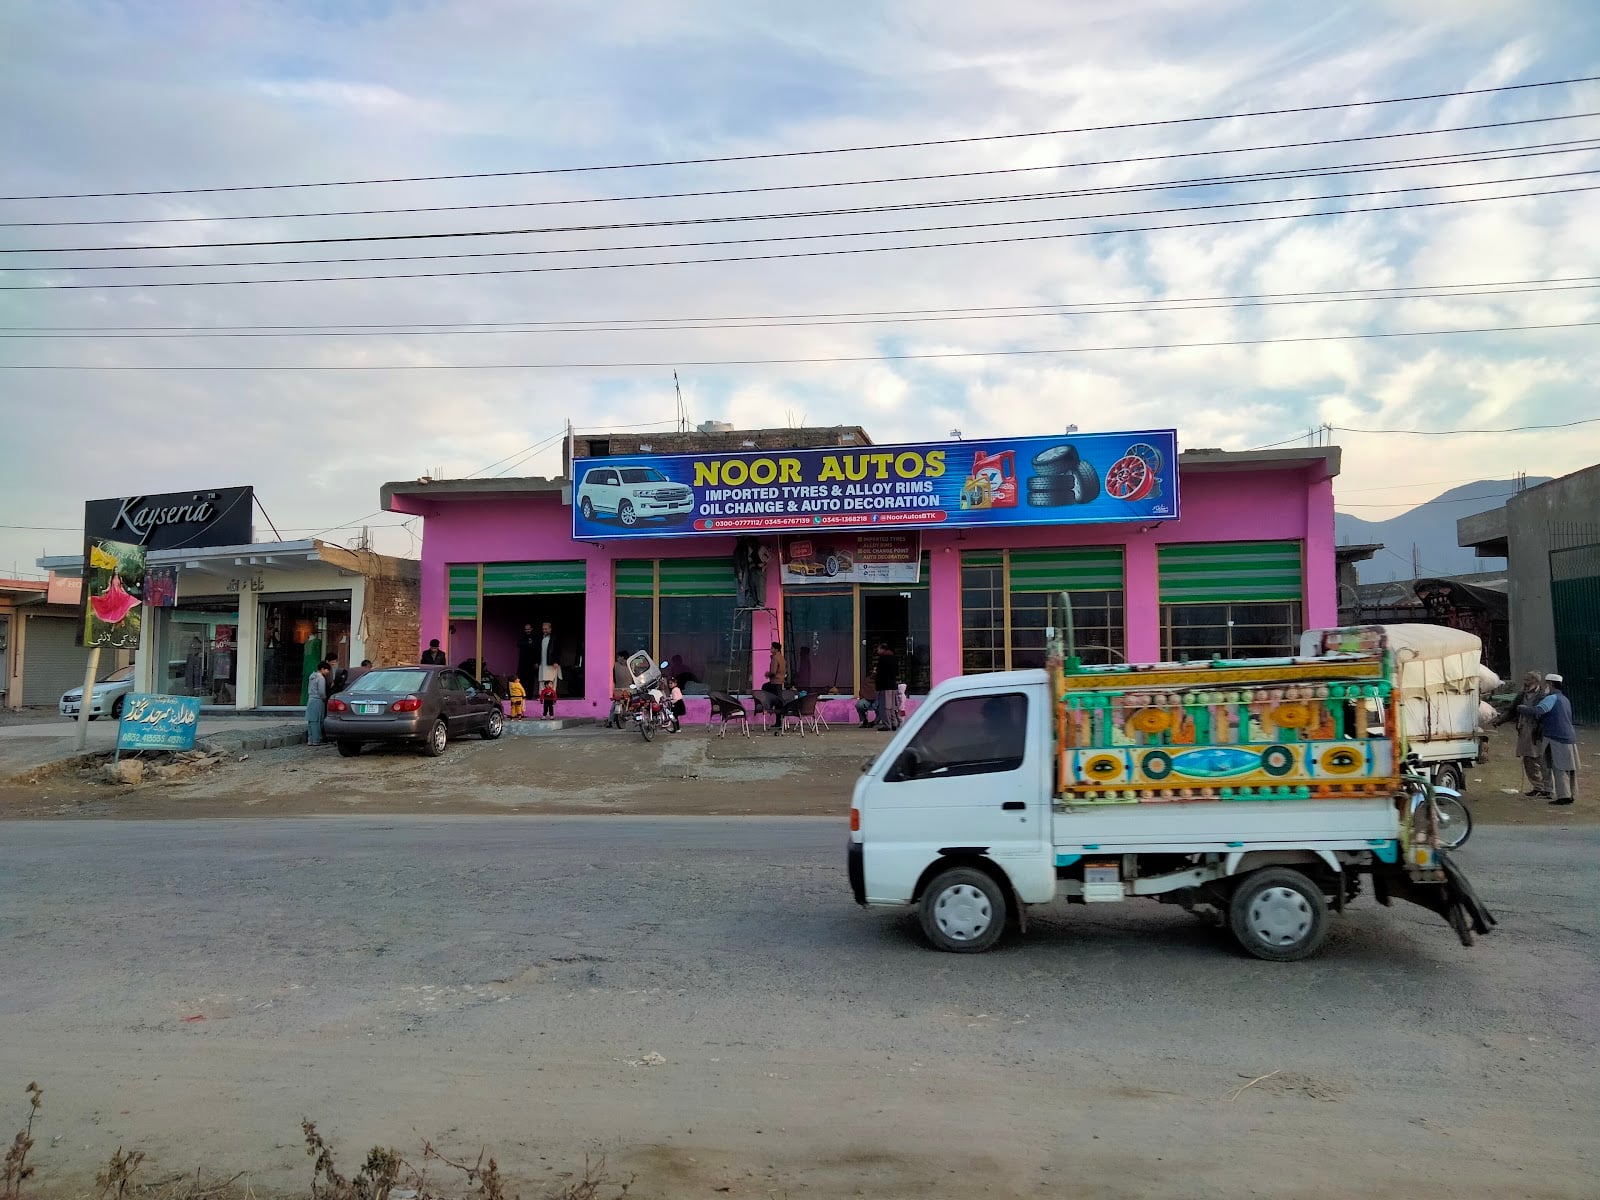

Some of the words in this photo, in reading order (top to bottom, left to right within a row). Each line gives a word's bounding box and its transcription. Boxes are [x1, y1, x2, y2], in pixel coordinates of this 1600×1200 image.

[693, 458, 802, 486] NOOR
[817, 450, 946, 482] AUTOS
[700, 503, 723, 516] OIL
[724, 500, 784, 515] CHANGE
[787, 500, 799, 512] &
[801, 498, 841, 512] AUTO
[843, 494, 940, 511] DECORATION
[705, 487, 779, 502] IMPORTED
[781, 485, 829, 499] TYRES
[831, 484, 842, 496] &
[845, 482, 893, 496] ALLOY
[895, 480, 934, 494] RIMS
[111, 495, 213, 546] Kayseria
